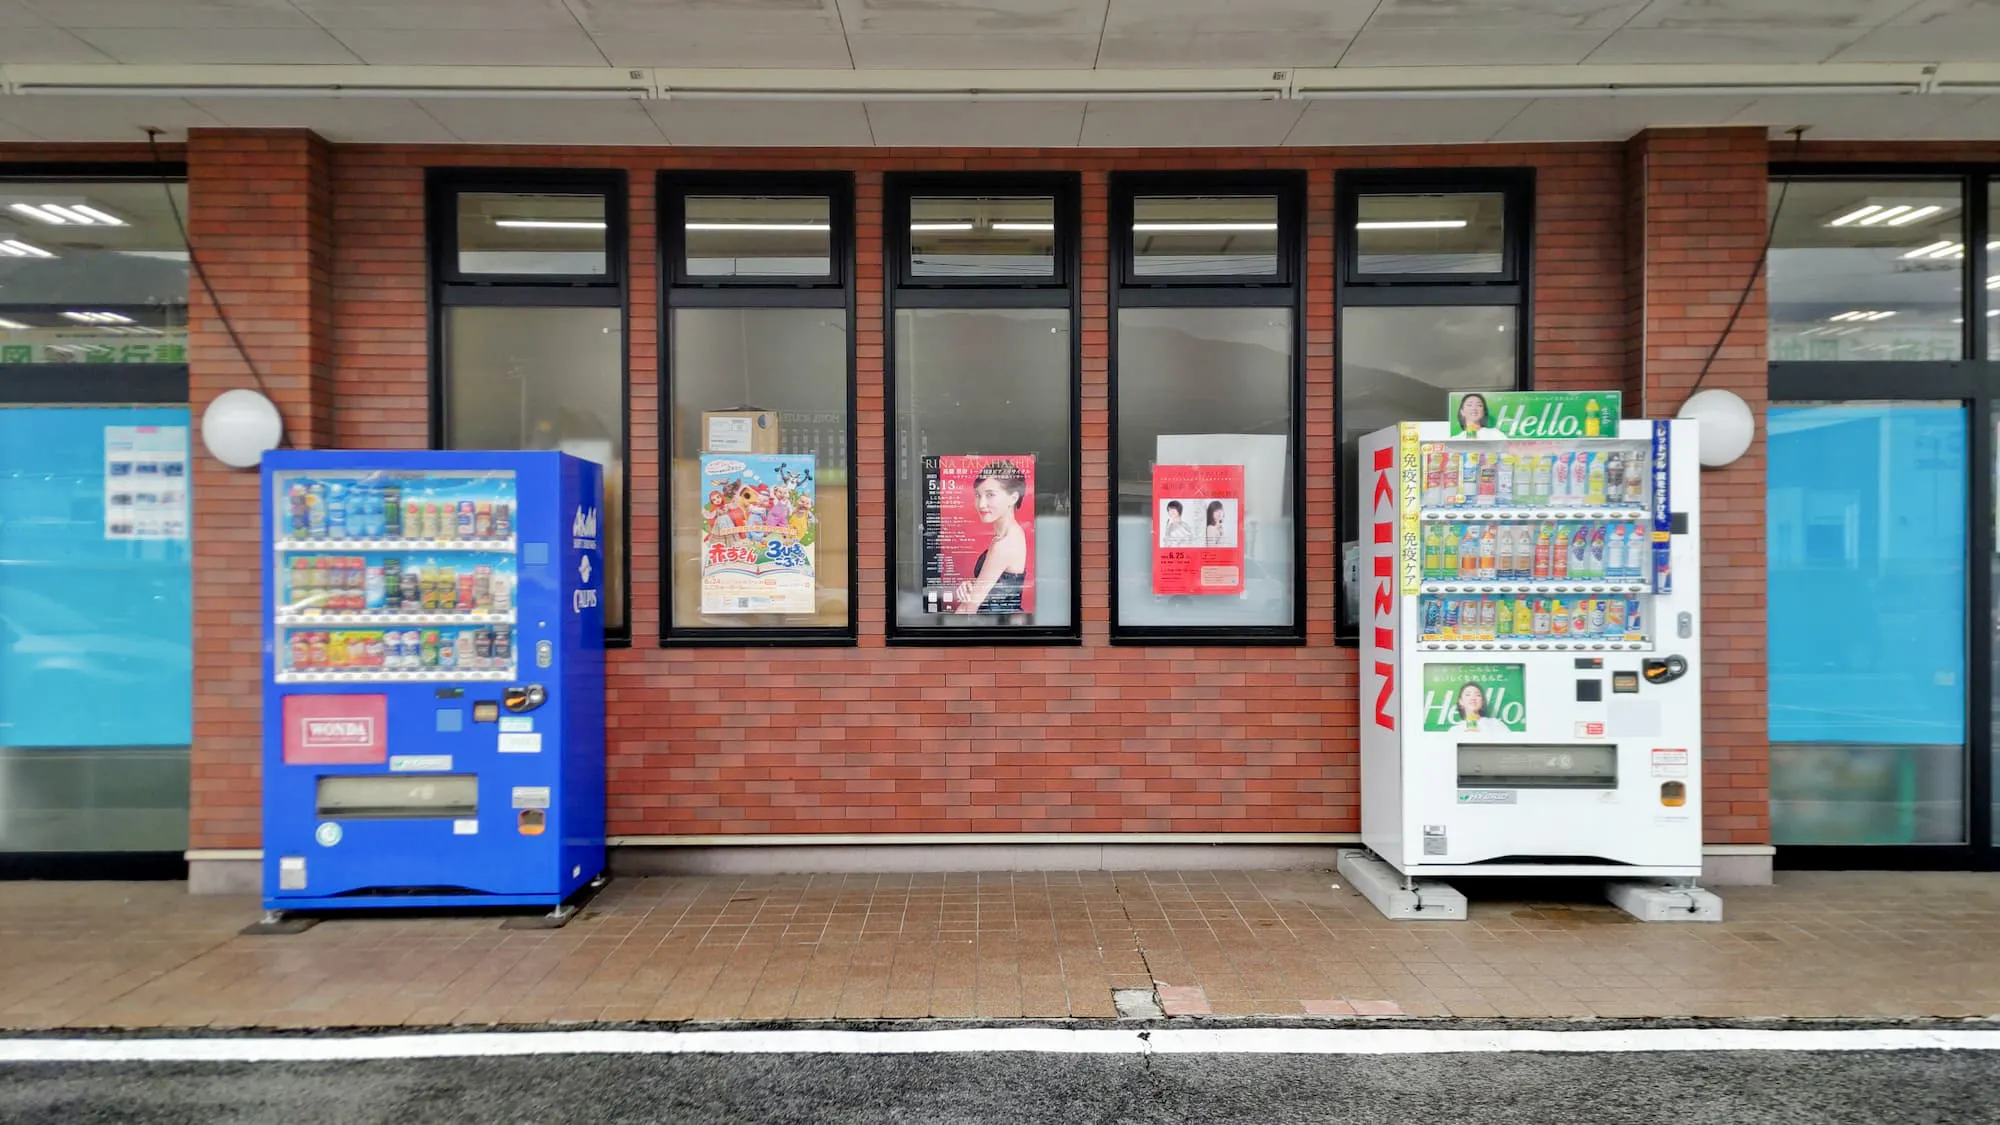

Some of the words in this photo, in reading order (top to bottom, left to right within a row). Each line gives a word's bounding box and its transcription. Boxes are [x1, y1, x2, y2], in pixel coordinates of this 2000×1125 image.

[1496, 402, 1583, 437] Hello.
[926, 459, 956, 469] RINA
[962, 459, 1030, 468] TAKAHASHI
[928, 480, 955, 490] 5.13
[1402, 453, 1417, 508] 免疫ケア
[1402, 532, 1417, 586] 免疫ケア
[573, 589, 597, 613] CALPIS
[1374, 446, 1395, 732] KIRIN
[309, 722, 367, 736] WONDA
